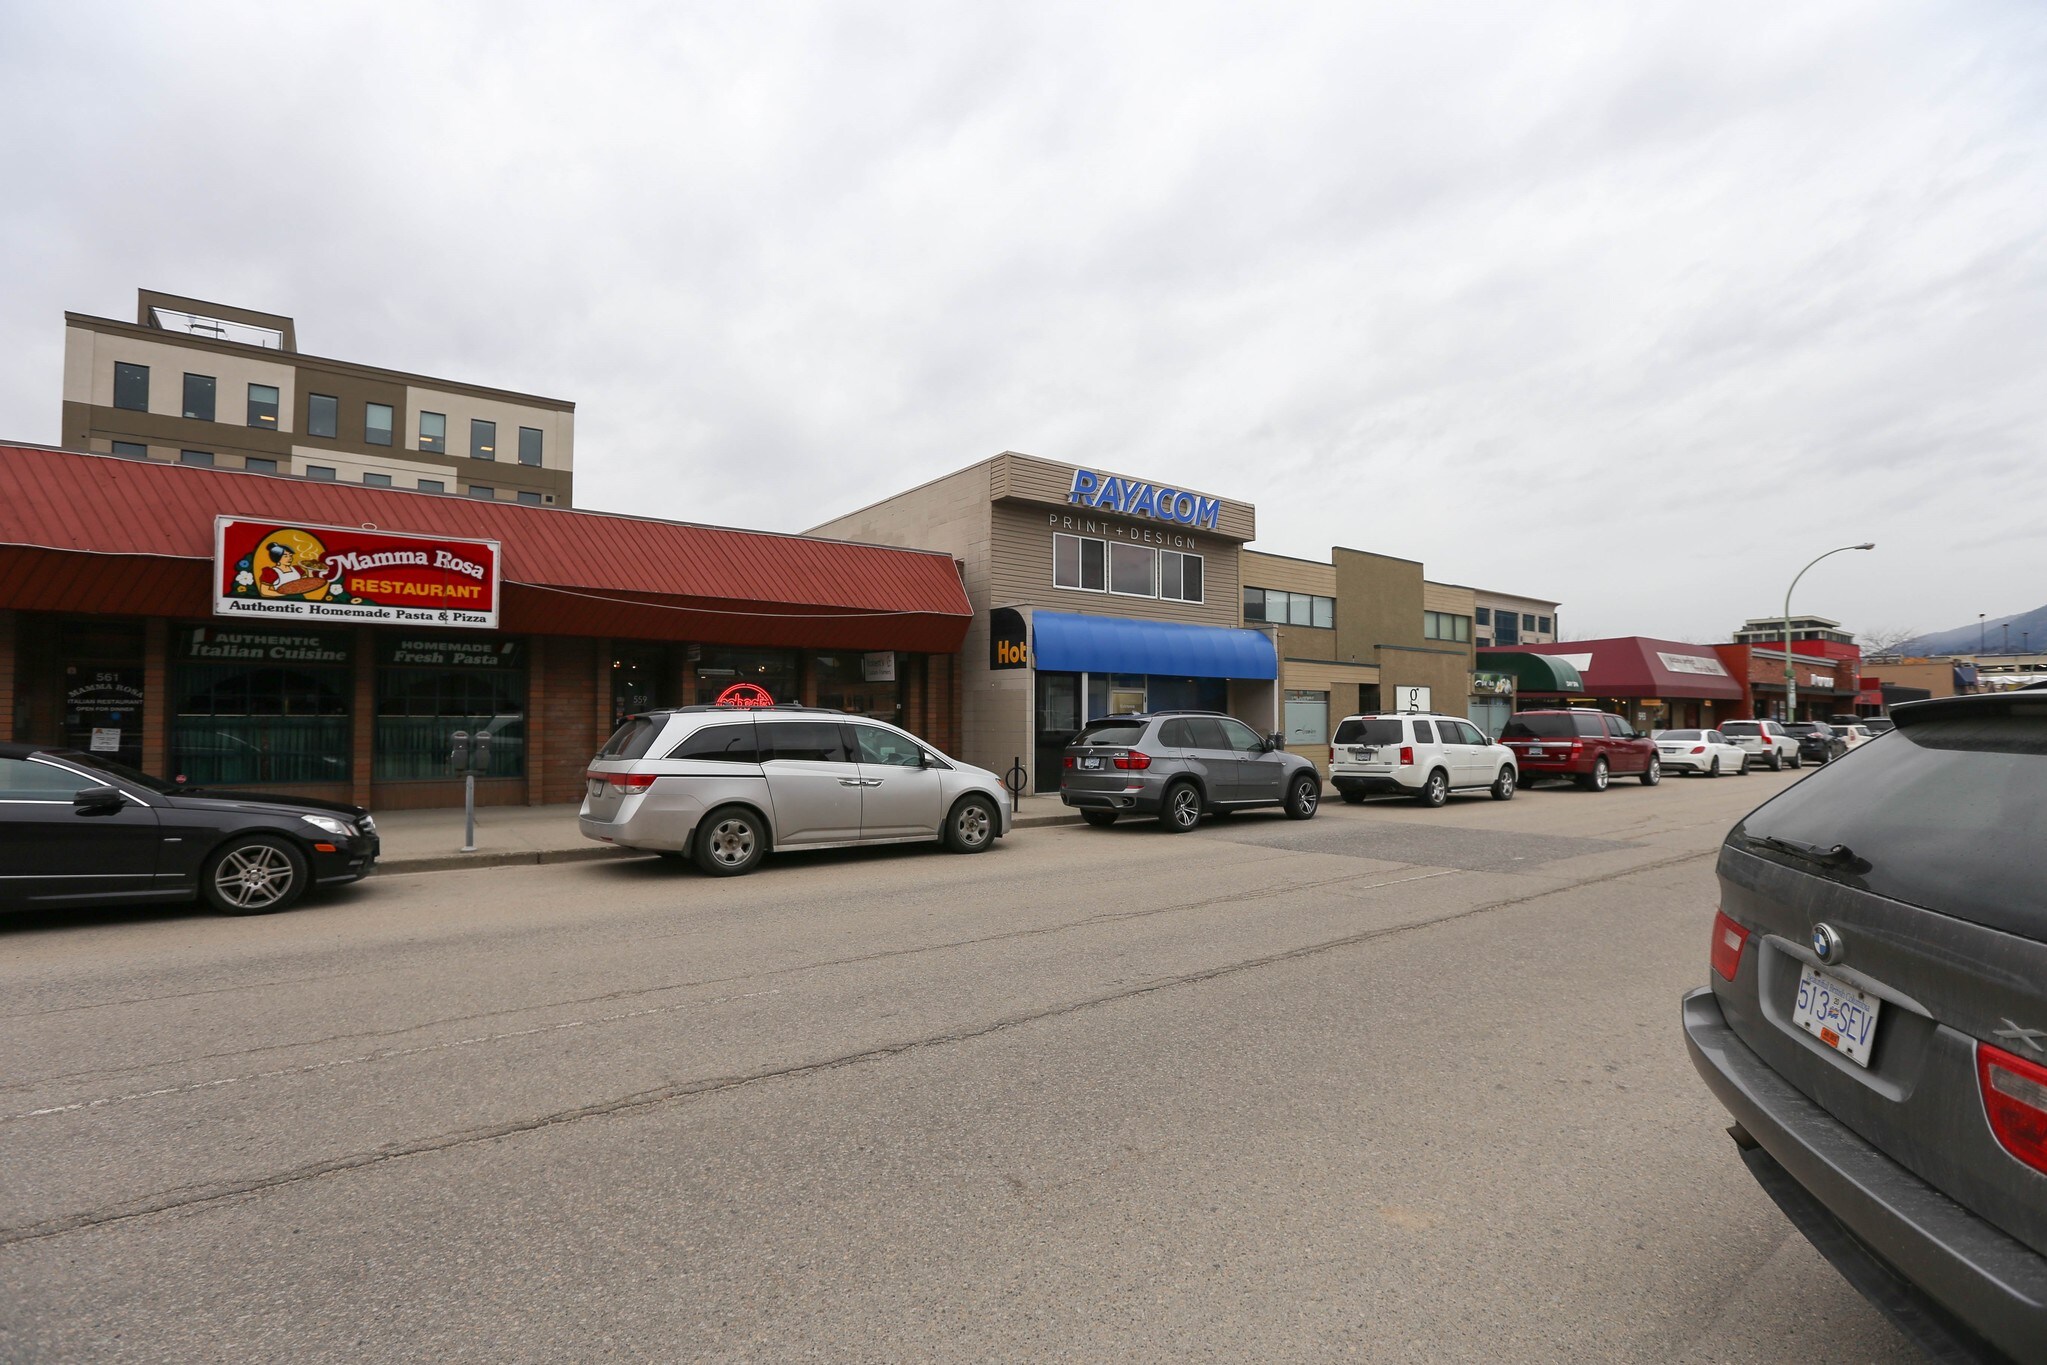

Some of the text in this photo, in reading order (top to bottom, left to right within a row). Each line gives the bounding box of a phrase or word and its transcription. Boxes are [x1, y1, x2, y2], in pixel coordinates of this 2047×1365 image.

[1068, 469, 1222, 529] RAYACOM
[1049, 514, 1108, 535] PRINT
[1130, 528, 1195, 549] DESIGN
[325, 550, 485, 582] Mamma Rosa
[351, 578, 482, 599] RESTAURANT
[229, 600, 487, 623] Authentic Homemade Pasta & Pizza
[215, 633, 320, 647] AUTHENTIC
[401, 640, 492, 653] HOMEMADE
[190, 643, 347, 661] Italian Cuisine
[394, 650, 498, 666] Fresh Pasta
[998, 640, 1027, 664] Hot
[96, 672, 119, 682] 561
[68, 683, 144, 698] MAMMA ROSA
[633, 695, 648, 704] 559
[1798, 979, 1830, 1021] 513
[1837, 1002, 1874, 1046] SEV
